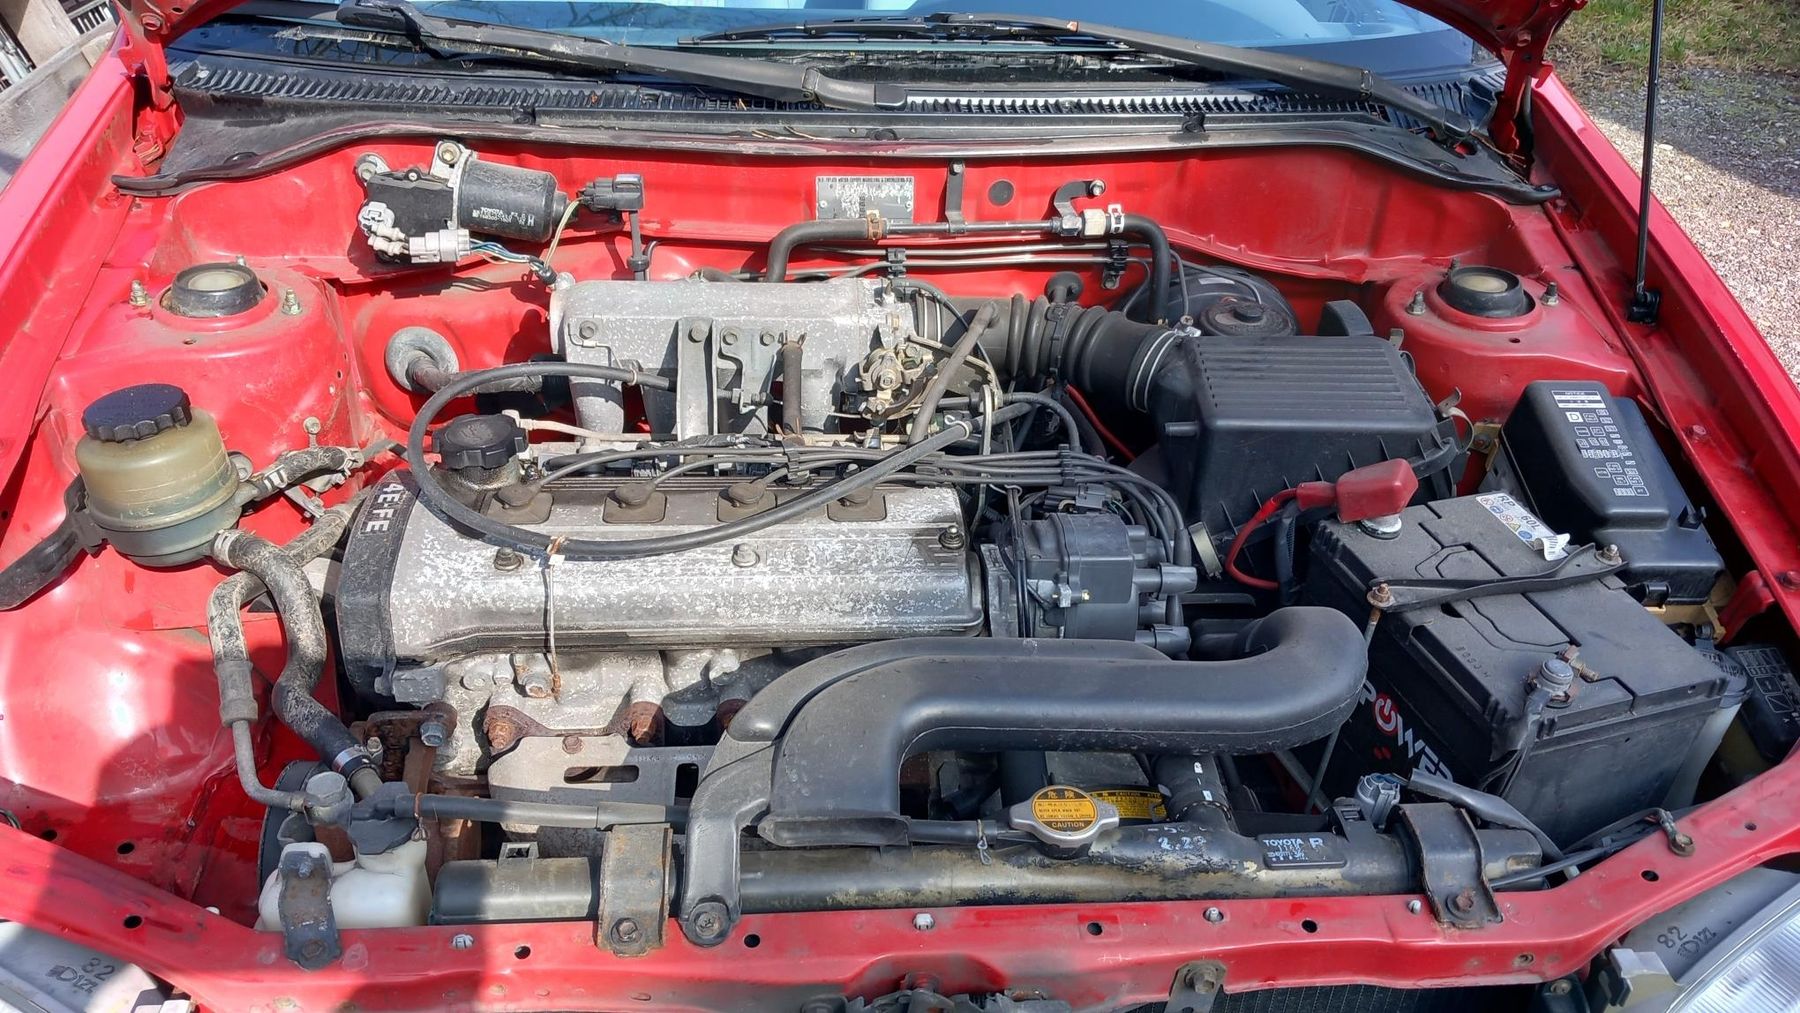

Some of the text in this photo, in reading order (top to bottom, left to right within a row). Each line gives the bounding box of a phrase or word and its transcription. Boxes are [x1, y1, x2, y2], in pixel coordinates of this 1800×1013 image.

[365, 483, 405, 532] 4E-FE
[1498, 495, 1516, 507] RP
[1051, 821, 1085, 829] CAUTION
[1262, 838, 1304, 847] TOYOTA
[1657, 925, 1688, 949] 82
[81, 957, 116, 982] 82
